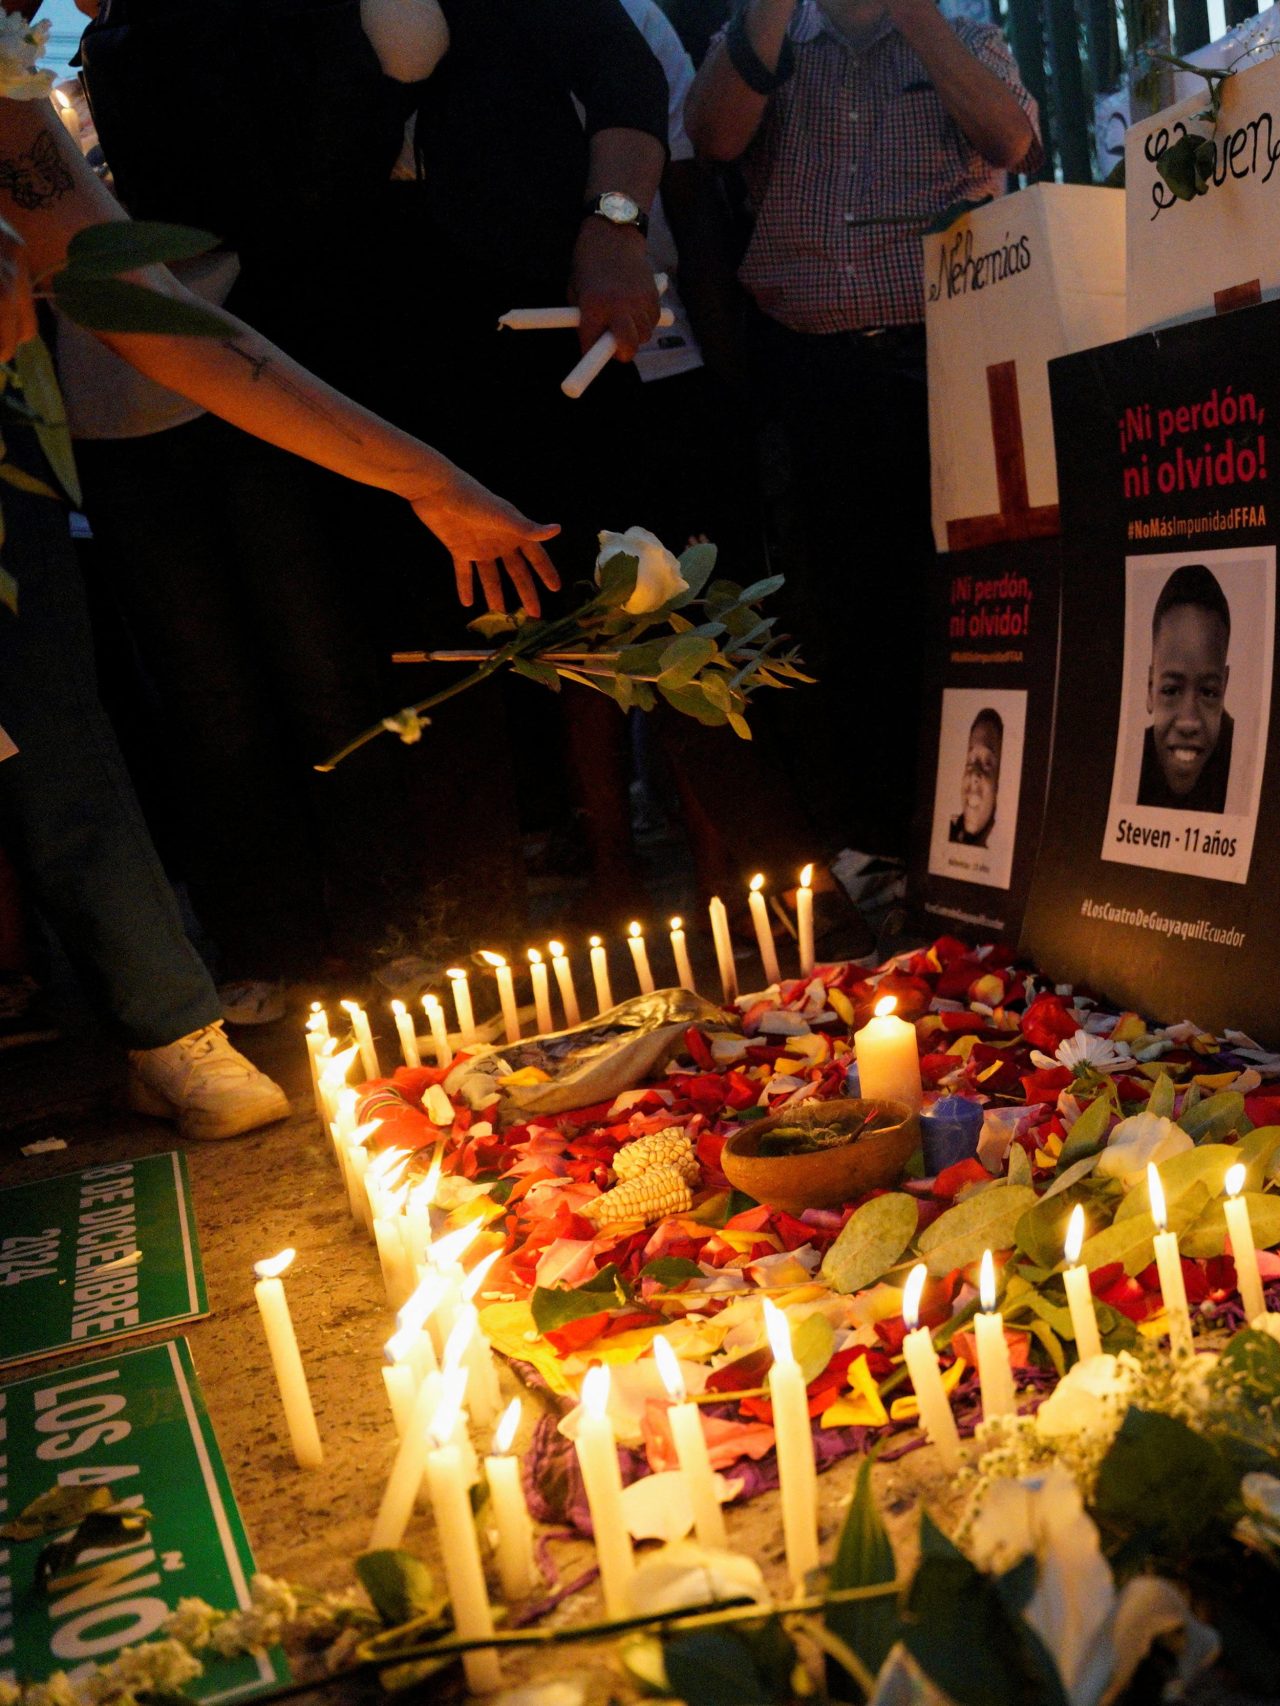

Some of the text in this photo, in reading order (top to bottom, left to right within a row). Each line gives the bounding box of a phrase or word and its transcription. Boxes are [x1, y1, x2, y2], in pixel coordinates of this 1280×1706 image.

[1118, 385, 1265, 453] ¡Ni perdón,
[1123, 435, 1267, 498] ni olvido!
[1127, 505, 1267, 540] #NoMásImpunidadFFAA
[974, 571, 1033, 606] perdón,
[950, 603, 1030, 638] ni olvido!
[1116, 819, 1172, 849] Steven
[1184, 827, 1200, 853] 11
[1202, 830, 1238, 858] años
[1080, 899, 1246, 948] #LosCuatroDeGuayaquilEcuador
[0, 1227, 62, 1287] 2024
[71, 1164, 140, 1340] 8 DE DICIEMBRE
[34, 1370, 132, 1461] LOS
